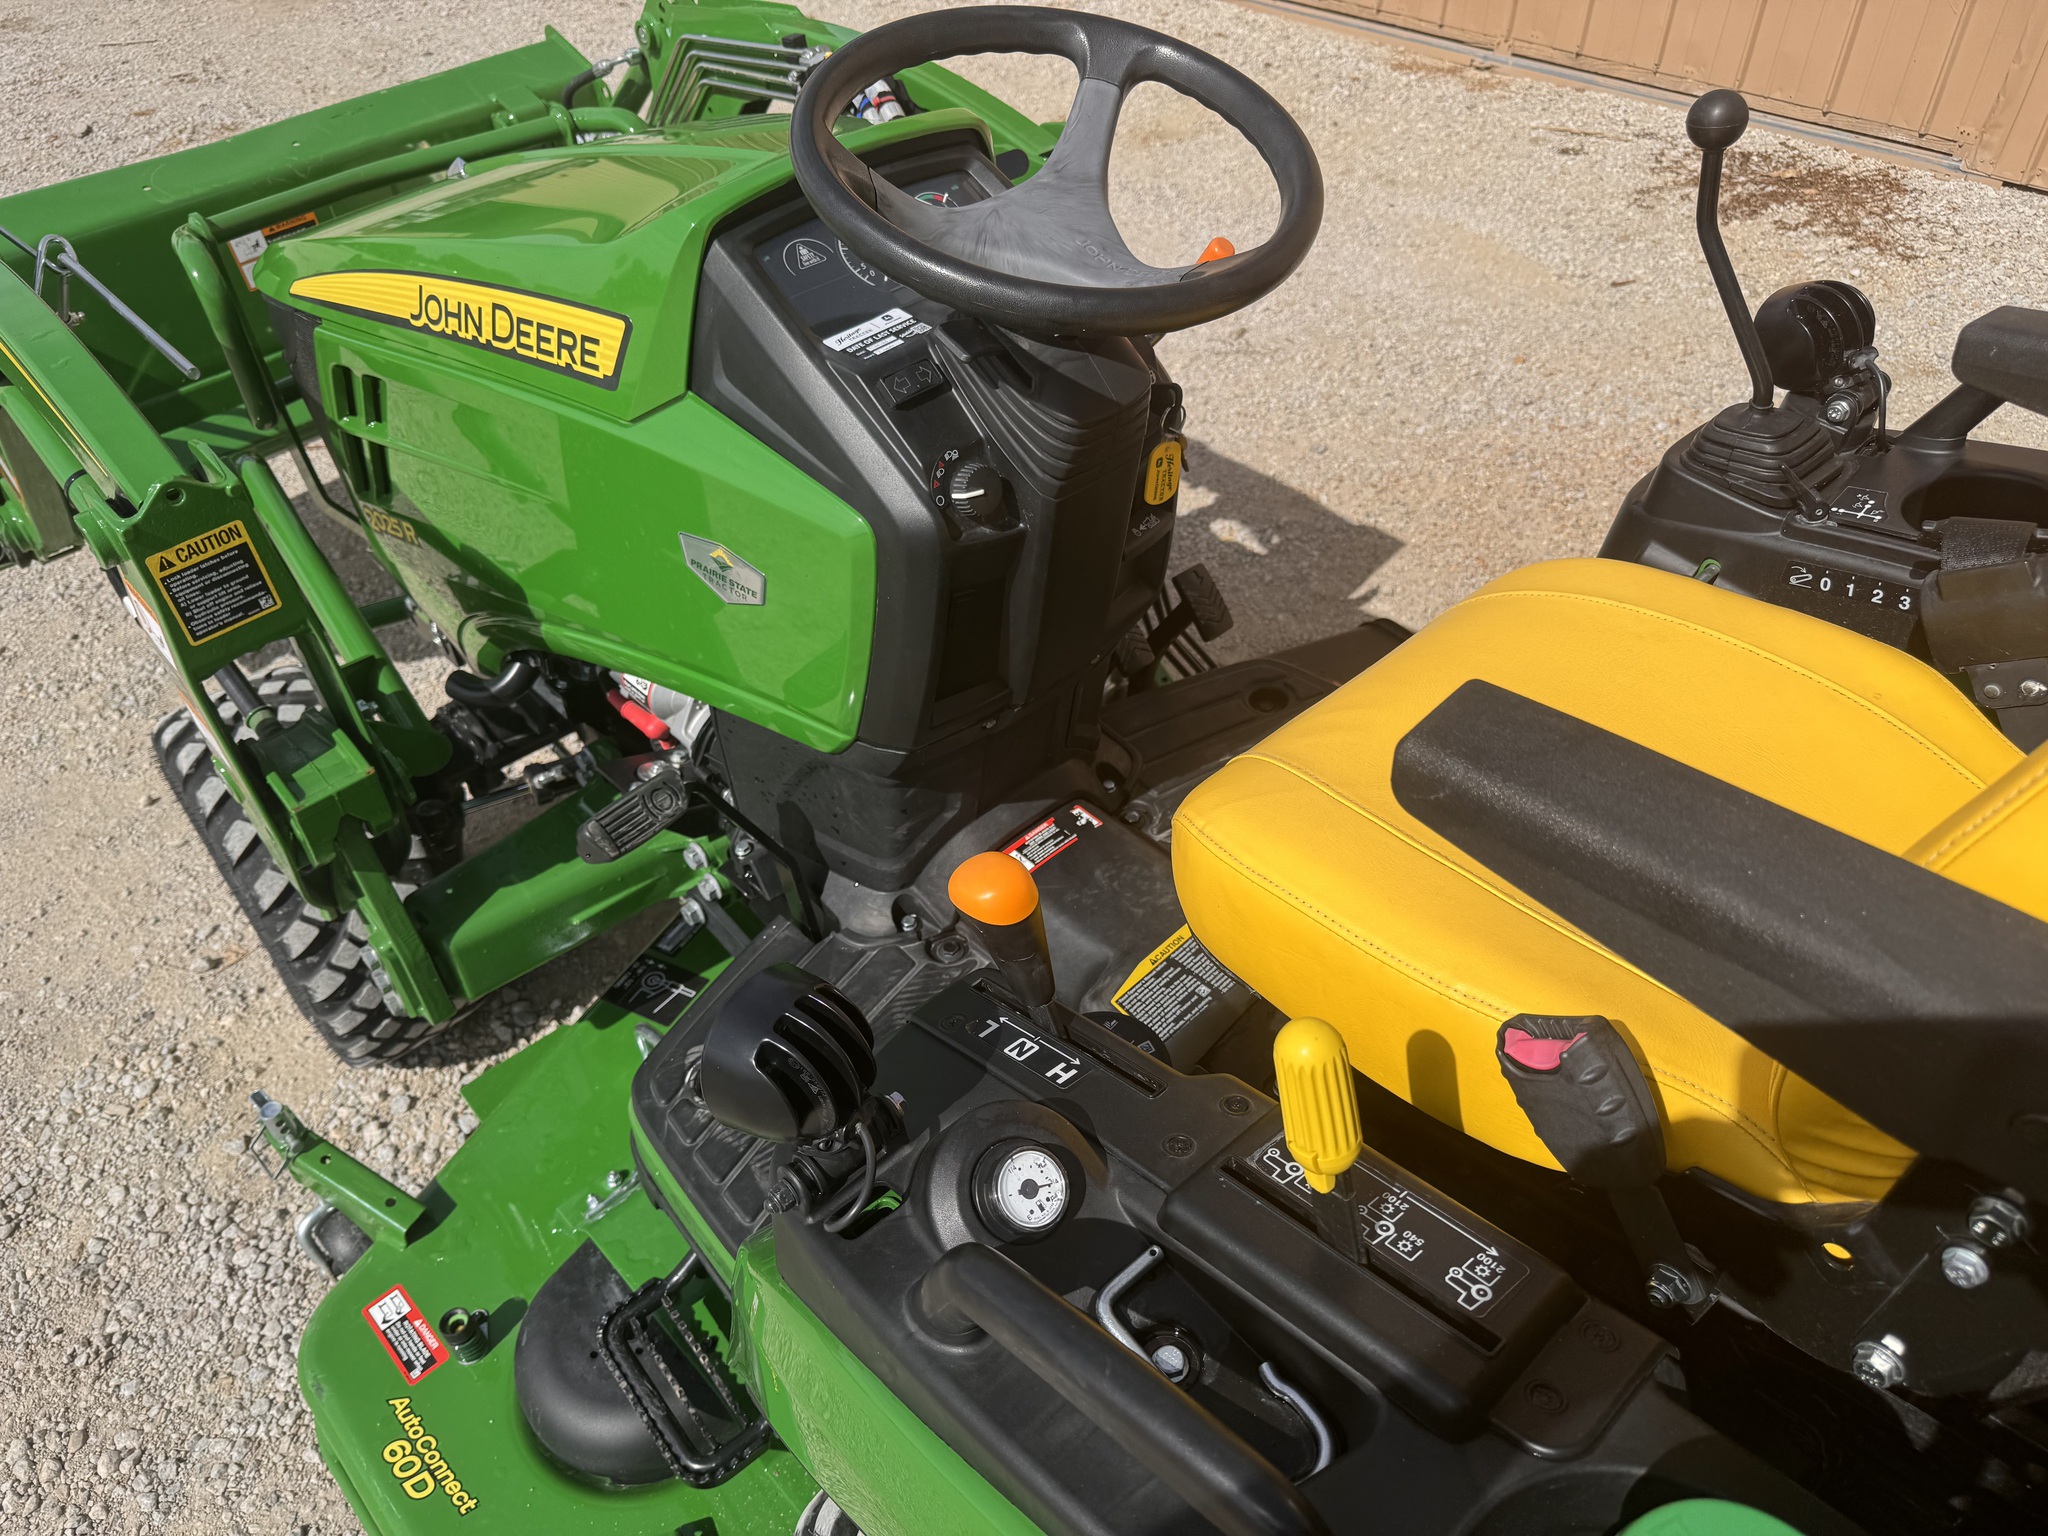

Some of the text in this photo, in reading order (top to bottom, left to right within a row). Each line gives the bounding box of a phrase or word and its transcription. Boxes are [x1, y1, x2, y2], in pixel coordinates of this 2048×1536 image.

[860, 262, 867, 270] 5
[410, 285, 600, 372] JOHN DEERE
[889, 318, 917, 335] SERVICE
[175, 524, 243, 563] CAUTION
[167, 550, 239, 583] Lock loader latches before
[690, 558, 758, 600] PRAIRIE STATE
[172, 582, 191, 593] Before
[702, 573, 748, 602] TRACTOR
[1820, 577, 1911, 610] 0 1 2 3
[1154, 935, 1185, 963] CAUTION
[978, 1019, 1079, 1084] L N H
[1382, 1191, 1410, 1211] 2100
[1402, 1230, 1425, 1247] 540
[1476, 1252, 1506, 1274] 2100
[382, 1438, 436, 1499] 60D
[387, 1396, 480, 1516] AutoConnect
